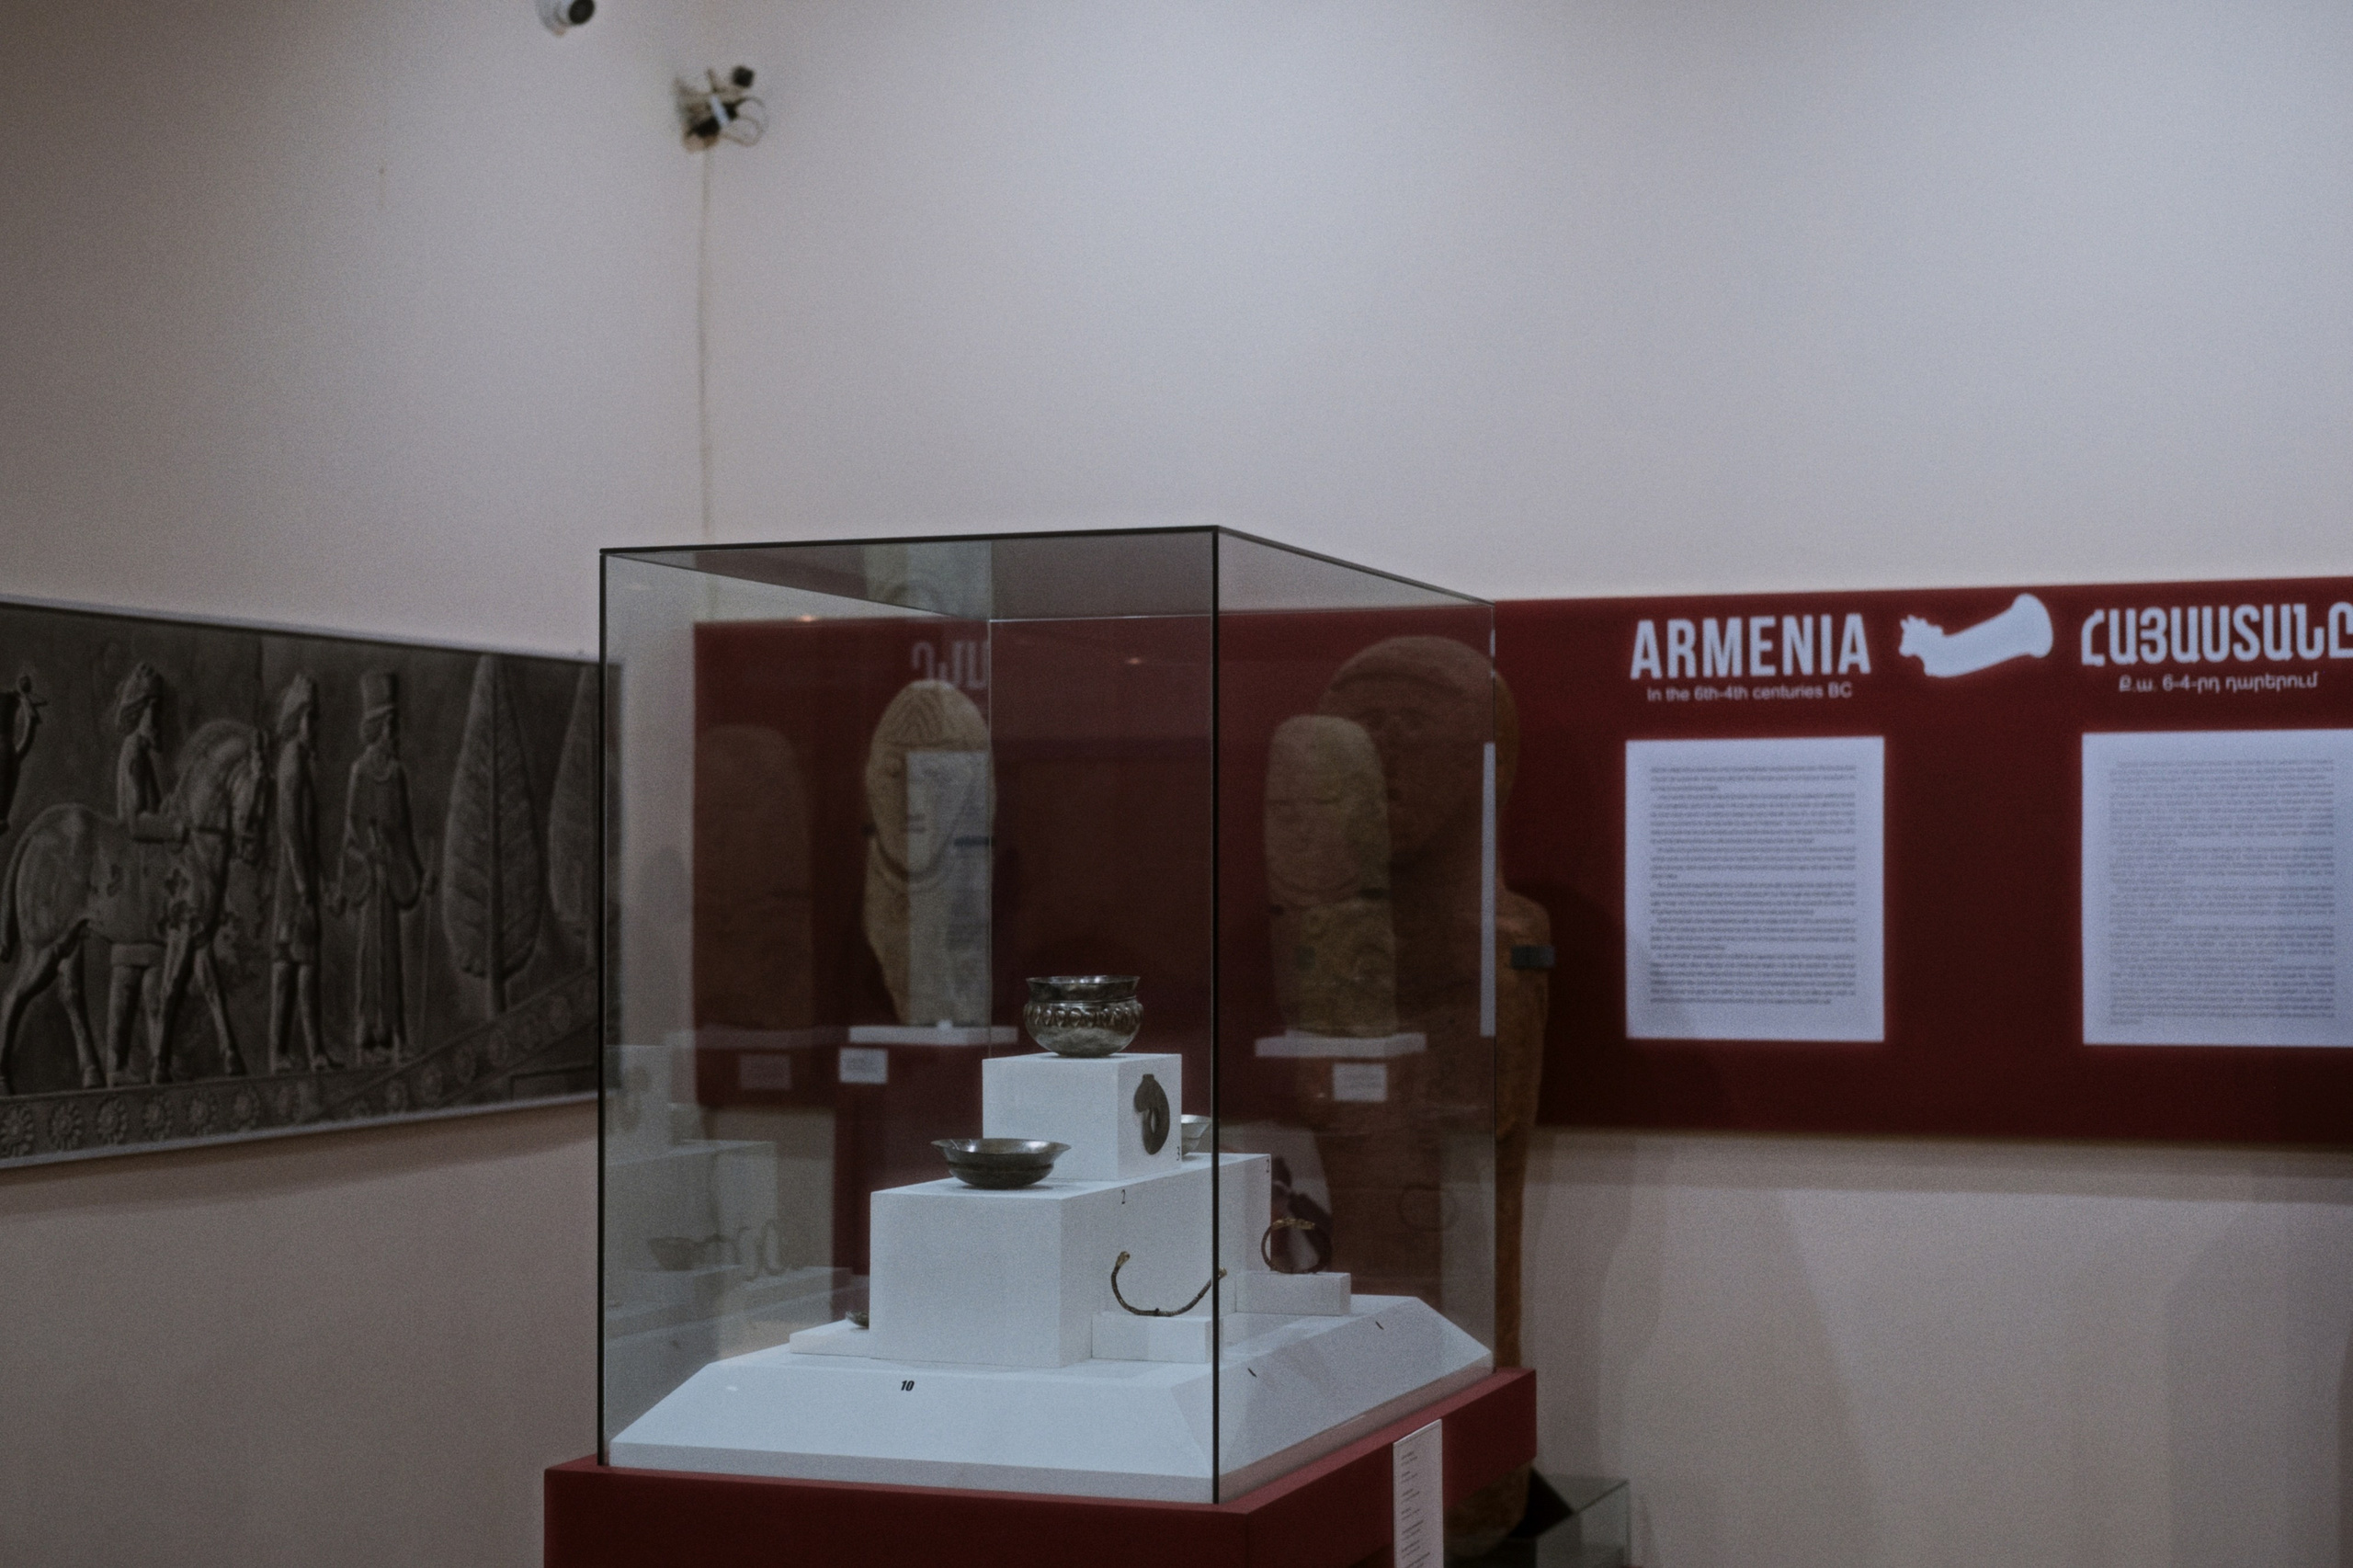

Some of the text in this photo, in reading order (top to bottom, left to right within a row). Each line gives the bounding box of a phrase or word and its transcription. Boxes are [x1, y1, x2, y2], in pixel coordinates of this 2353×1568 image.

[1630, 613, 1871, 680] ARMENIA
[1665, 686, 1690, 702] the
[1693, 684, 1749, 701] 6th-4th
[1752, 684, 1824, 700] centuries
[1827, 681, 1853, 699] BC
[1120, 1188, 1127, 1205] 2
[901, 1380, 915, 1392] 10
